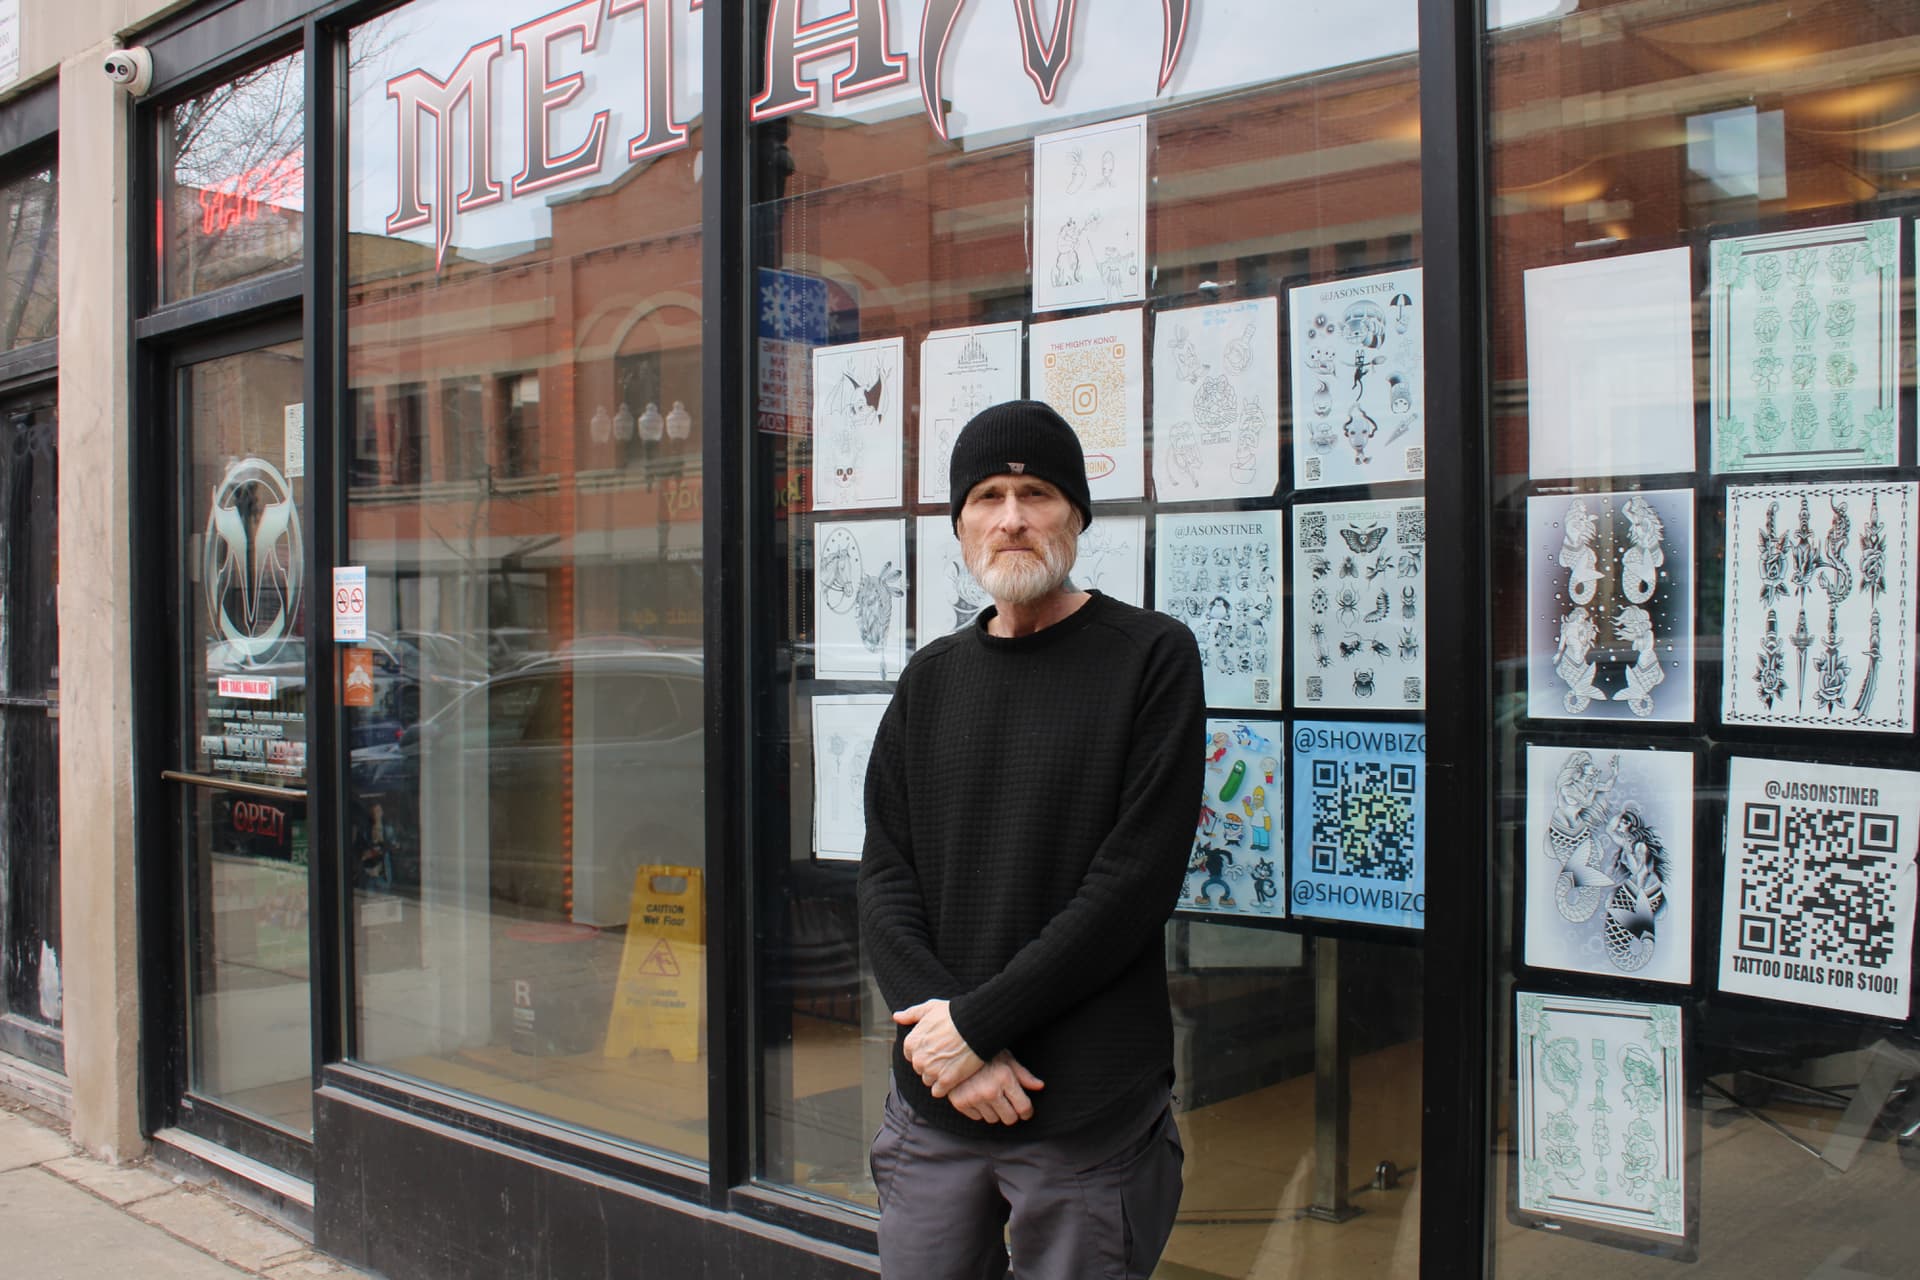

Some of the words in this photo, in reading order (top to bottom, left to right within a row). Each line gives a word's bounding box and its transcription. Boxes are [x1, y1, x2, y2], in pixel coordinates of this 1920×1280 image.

[1066, 338, 1093, 349] MIGHTY
[1175, 523, 1263, 539] @JASONSTINER
[1765, 780, 1879, 807] @JASONSTINER
[233, 800, 285, 847] OPEN
[646, 903, 684, 915] CAUTION
[643, 915, 659, 925] Wet
[664, 916, 686, 927] Floor
[1732, 955, 1780, 978] TATTOO
[1784, 963, 1825, 984] DEALS
[1828, 969, 1854, 989] FOR
[1857, 972, 1898, 995] $100!
